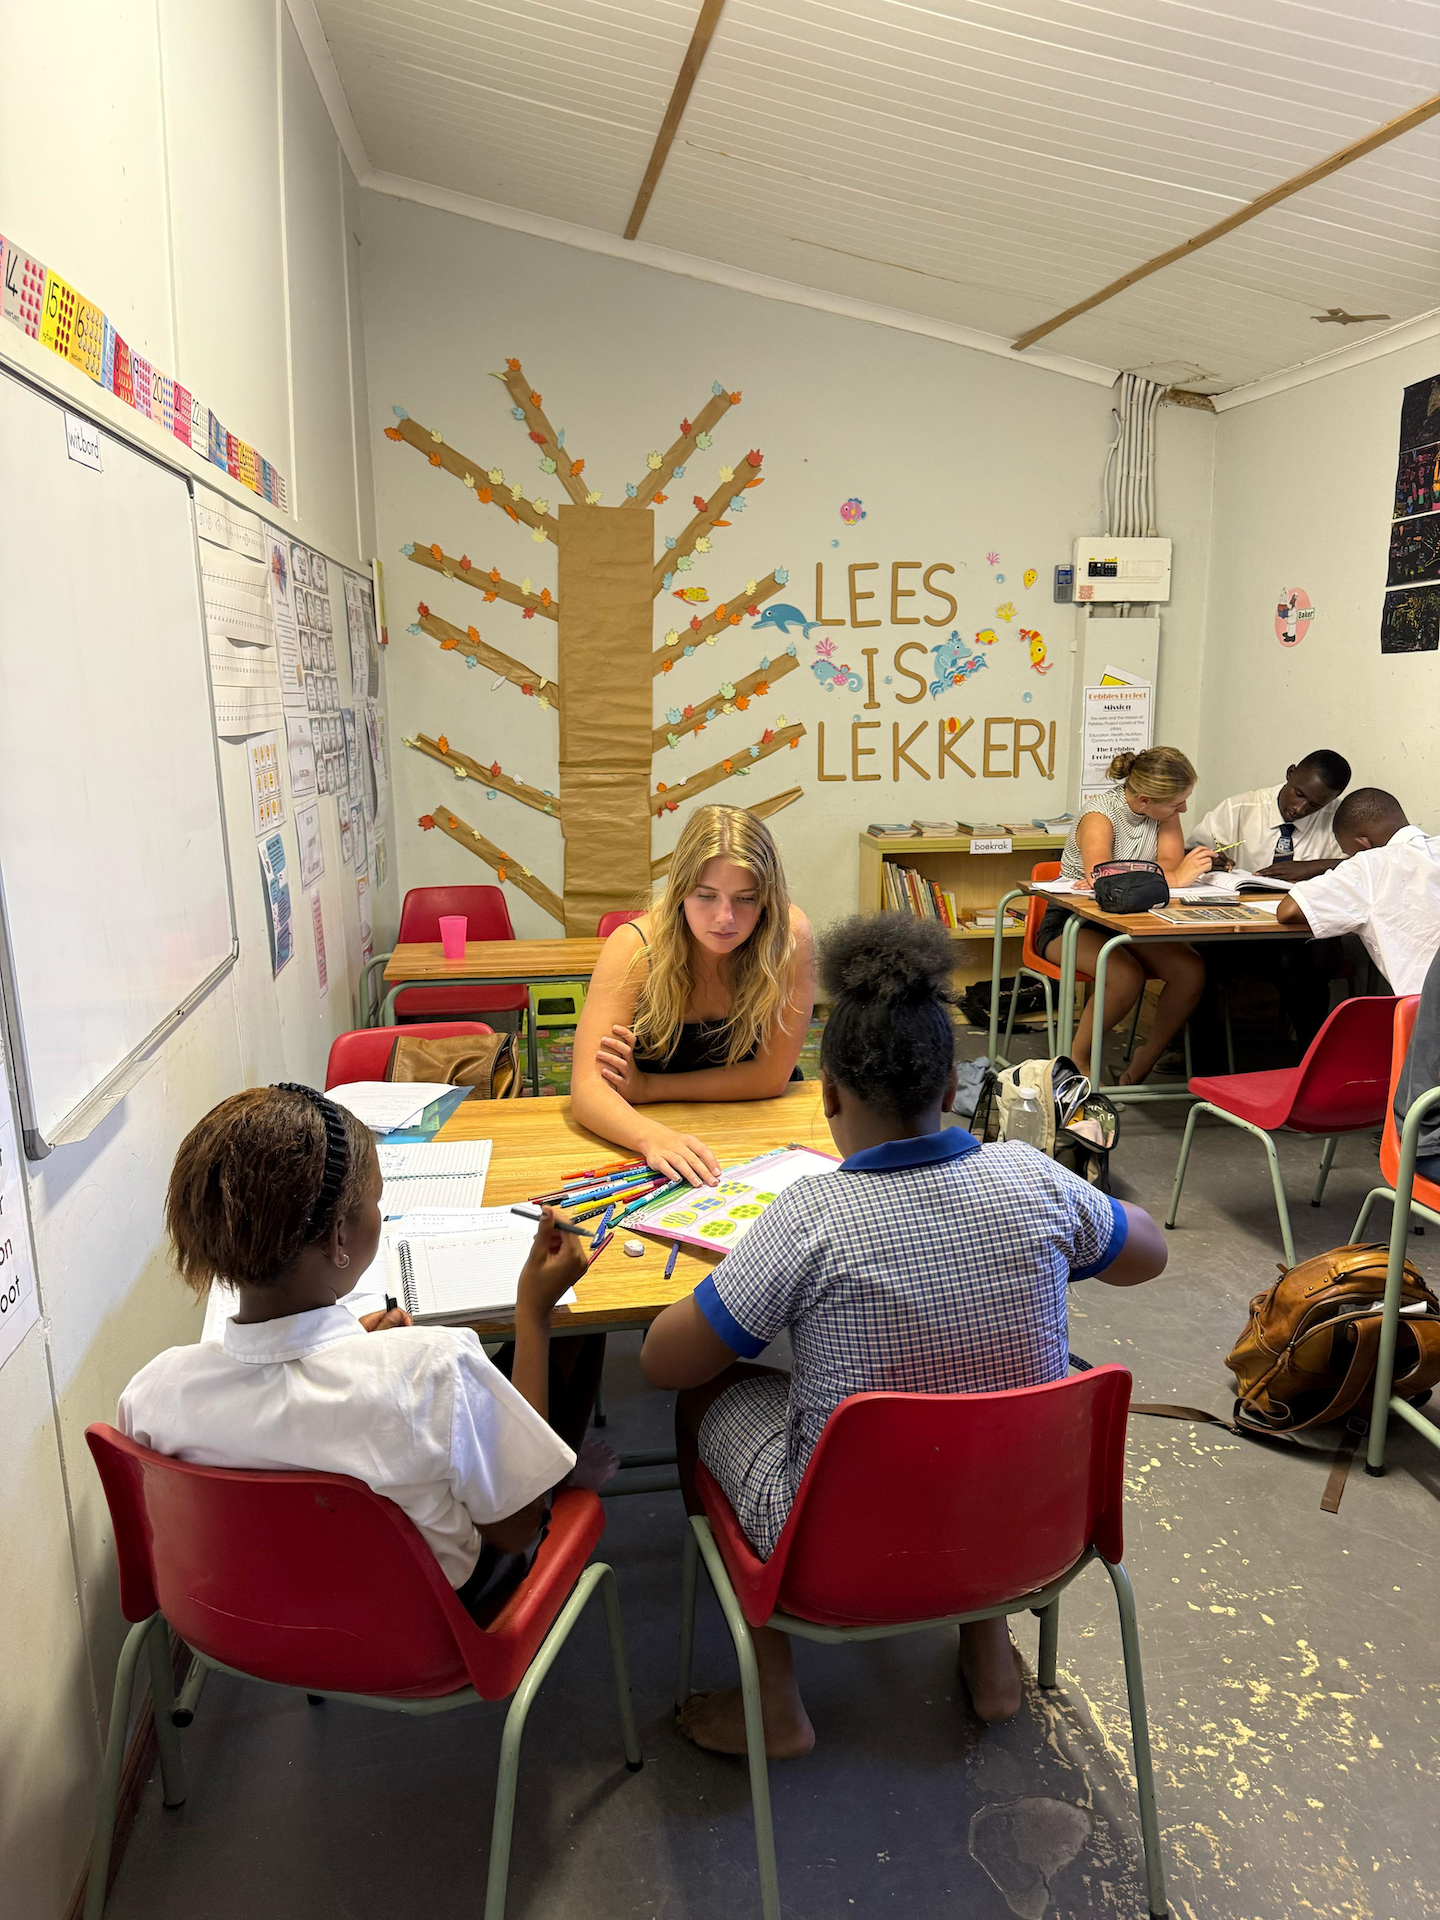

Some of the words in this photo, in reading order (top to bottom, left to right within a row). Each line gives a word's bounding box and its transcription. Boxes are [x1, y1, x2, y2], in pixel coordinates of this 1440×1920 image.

[6, 249, 18, 297] 14
[46, 279, 60, 318] 15
[74, 302, 85, 338] 16
[153, 373, 163, 404] 20
[192, 399, 199, 426] 22
[68, 426, 99, 459] witbord
[815, 561, 958, 628] LEES
[1298, 610, 1314, 619] Baker
[861, 641, 928, 709] IS
[818, 716, 1056, 782] LEKKER!
[974, 840, 1008, 850] boekrak
